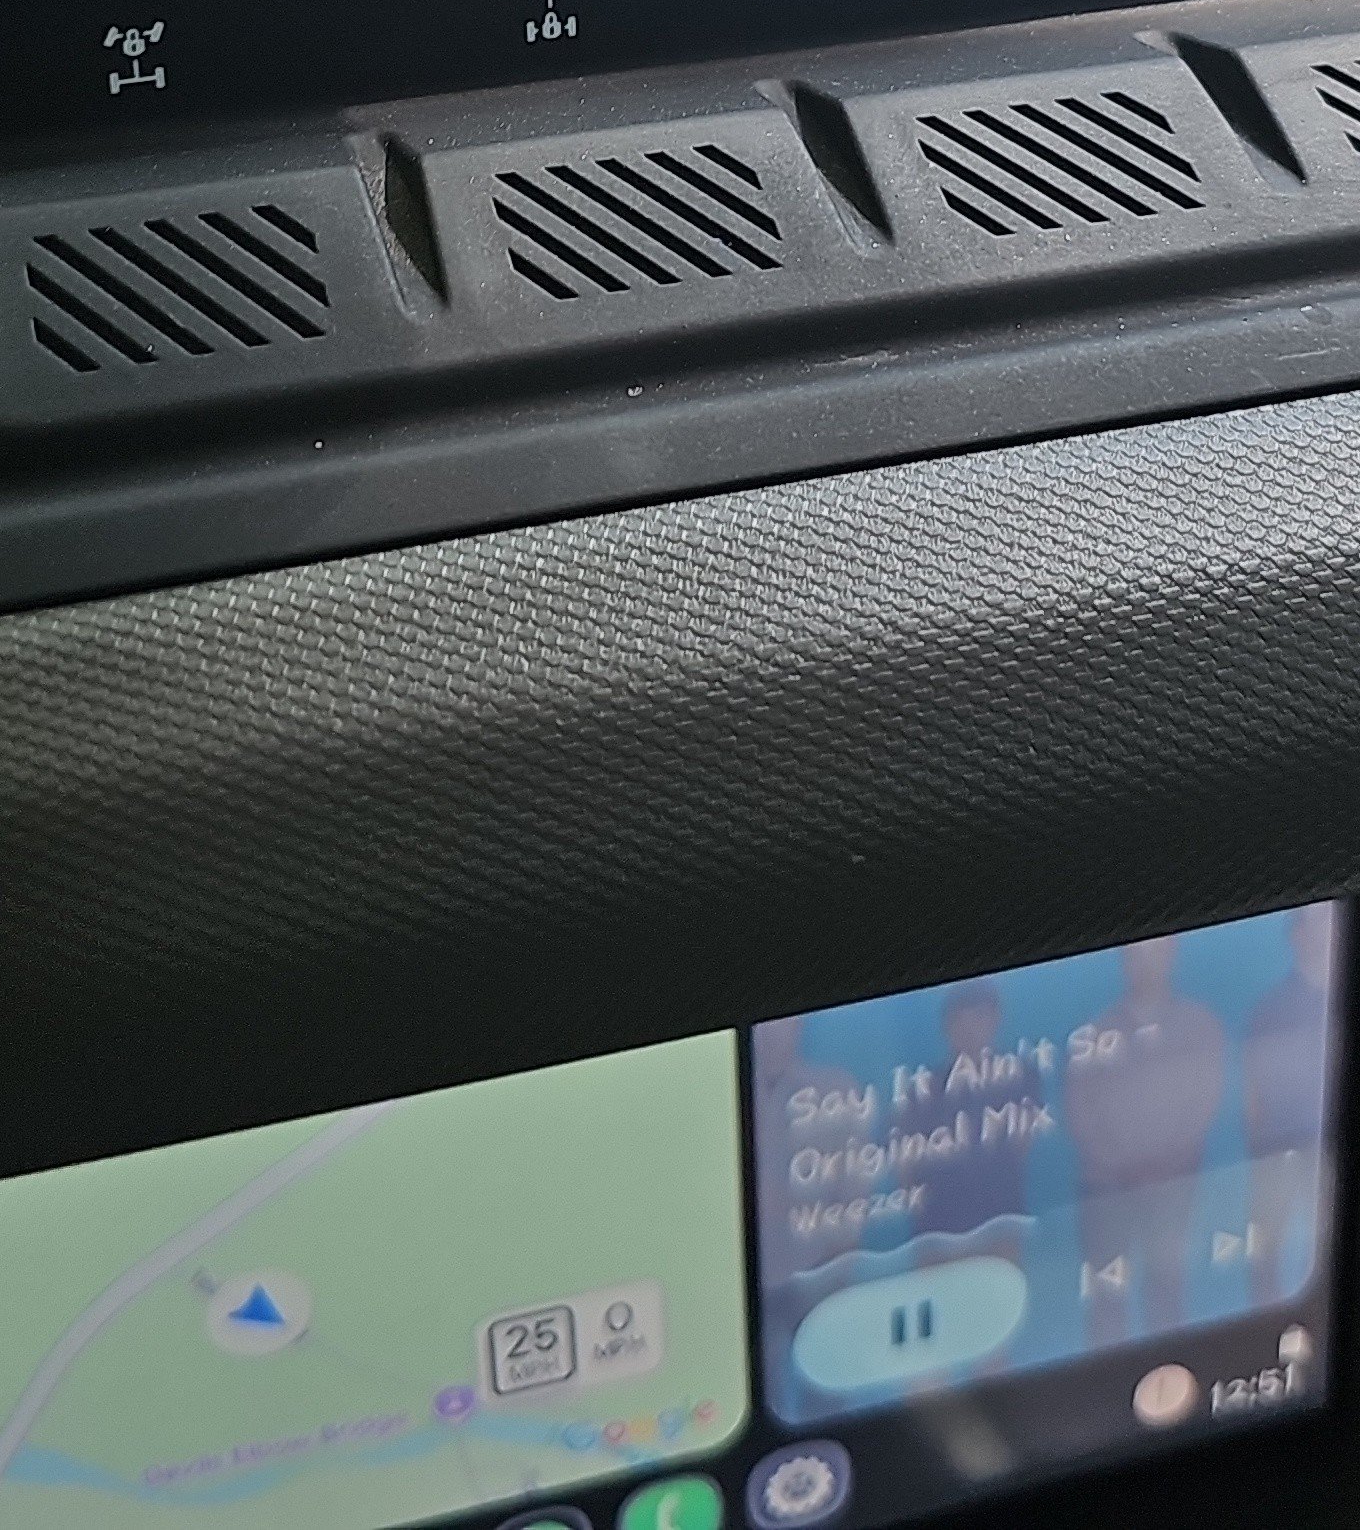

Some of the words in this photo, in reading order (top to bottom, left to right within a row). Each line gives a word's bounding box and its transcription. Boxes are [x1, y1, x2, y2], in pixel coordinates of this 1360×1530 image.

[786, 1084, 877, 1130] Say
[892, 1065, 932, 1106] It
[945, 1037, 1055, 1095] Ain't
[1066, 1022, 1124, 1064] So
[788, 1109, 971, 1186] Original
[980, 1096, 1056, 1144] Mix
[788, 1182, 926, 1236] Weezer
[504, 1317, 560, 1360] 25
[1210, 1362, 1297, 1419] 12:51
